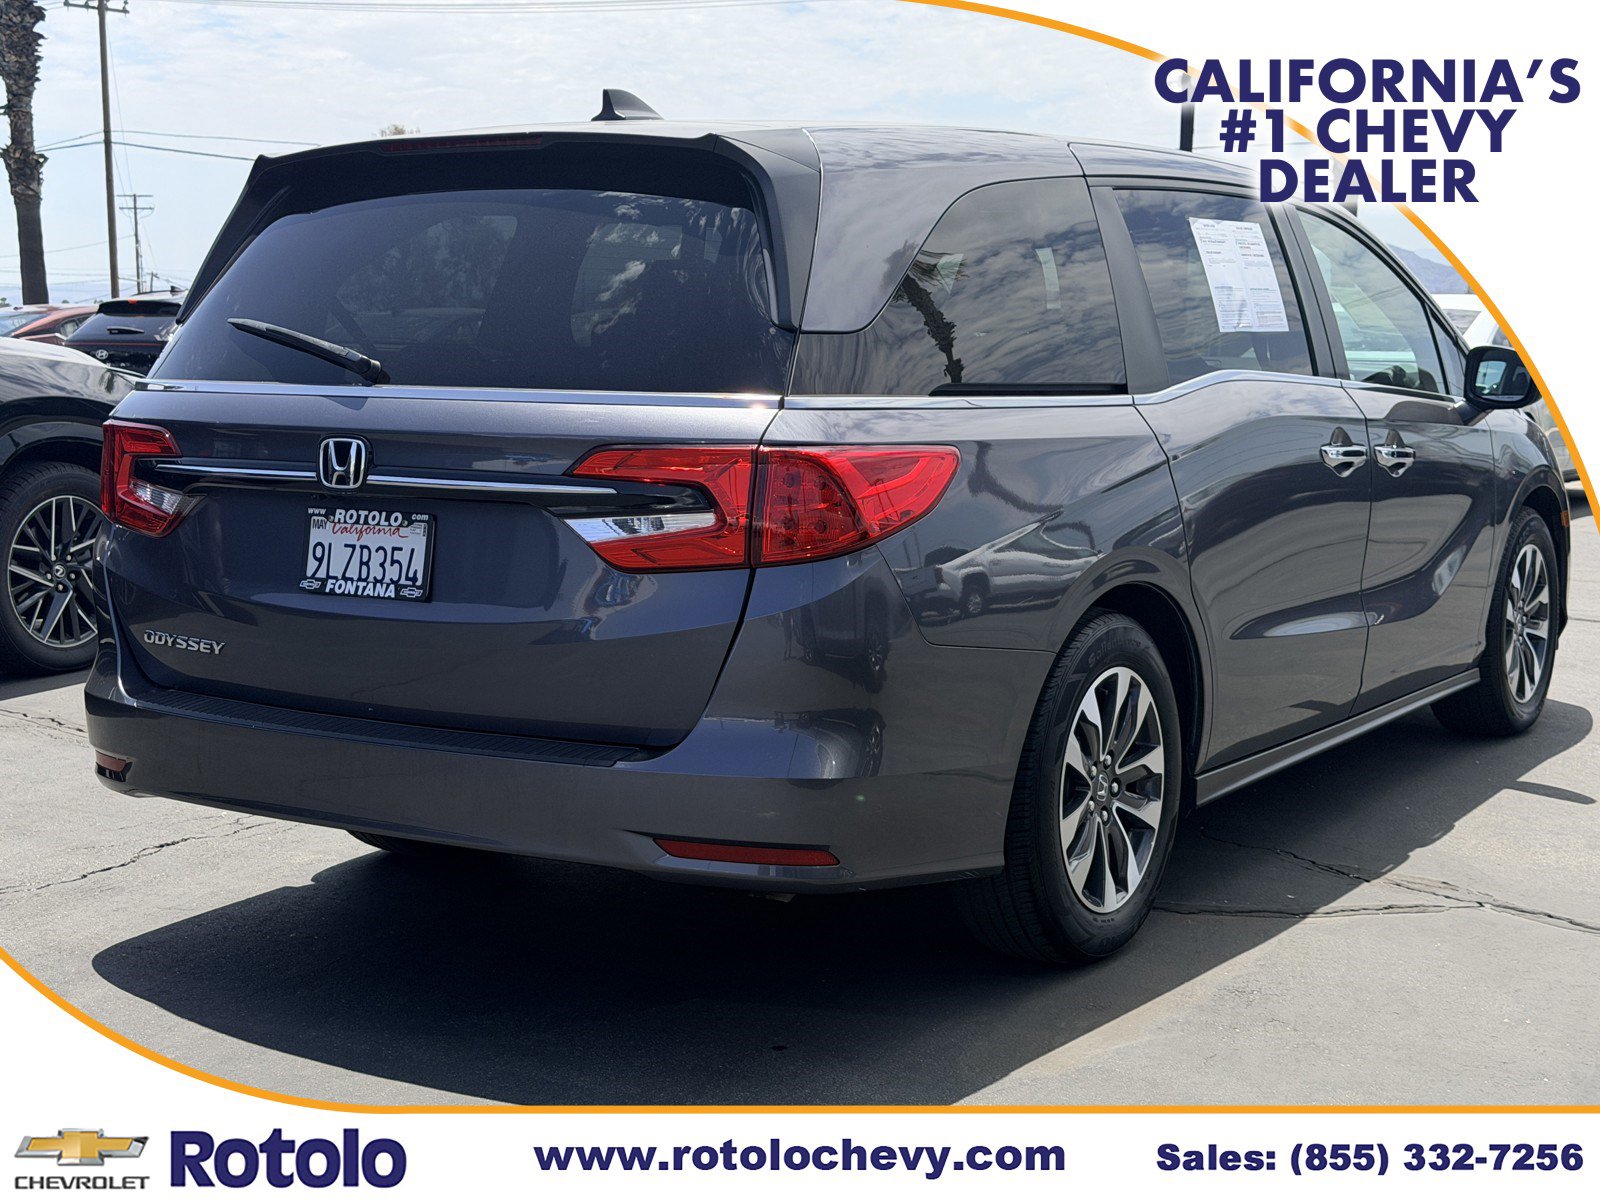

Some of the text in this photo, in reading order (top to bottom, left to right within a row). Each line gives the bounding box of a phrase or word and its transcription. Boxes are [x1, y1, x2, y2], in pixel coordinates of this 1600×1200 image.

[313, 518, 328, 530] MAY
[334, 509, 403, 526] ROTOLO
[411, 513, 429, 521] com
[331, 522, 408, 541] California
[309, 541, 418, 586] 9LZB354
[325, 579, 395, 598] FONTANA
[143, 629, 226, 655] ODYSSEY
